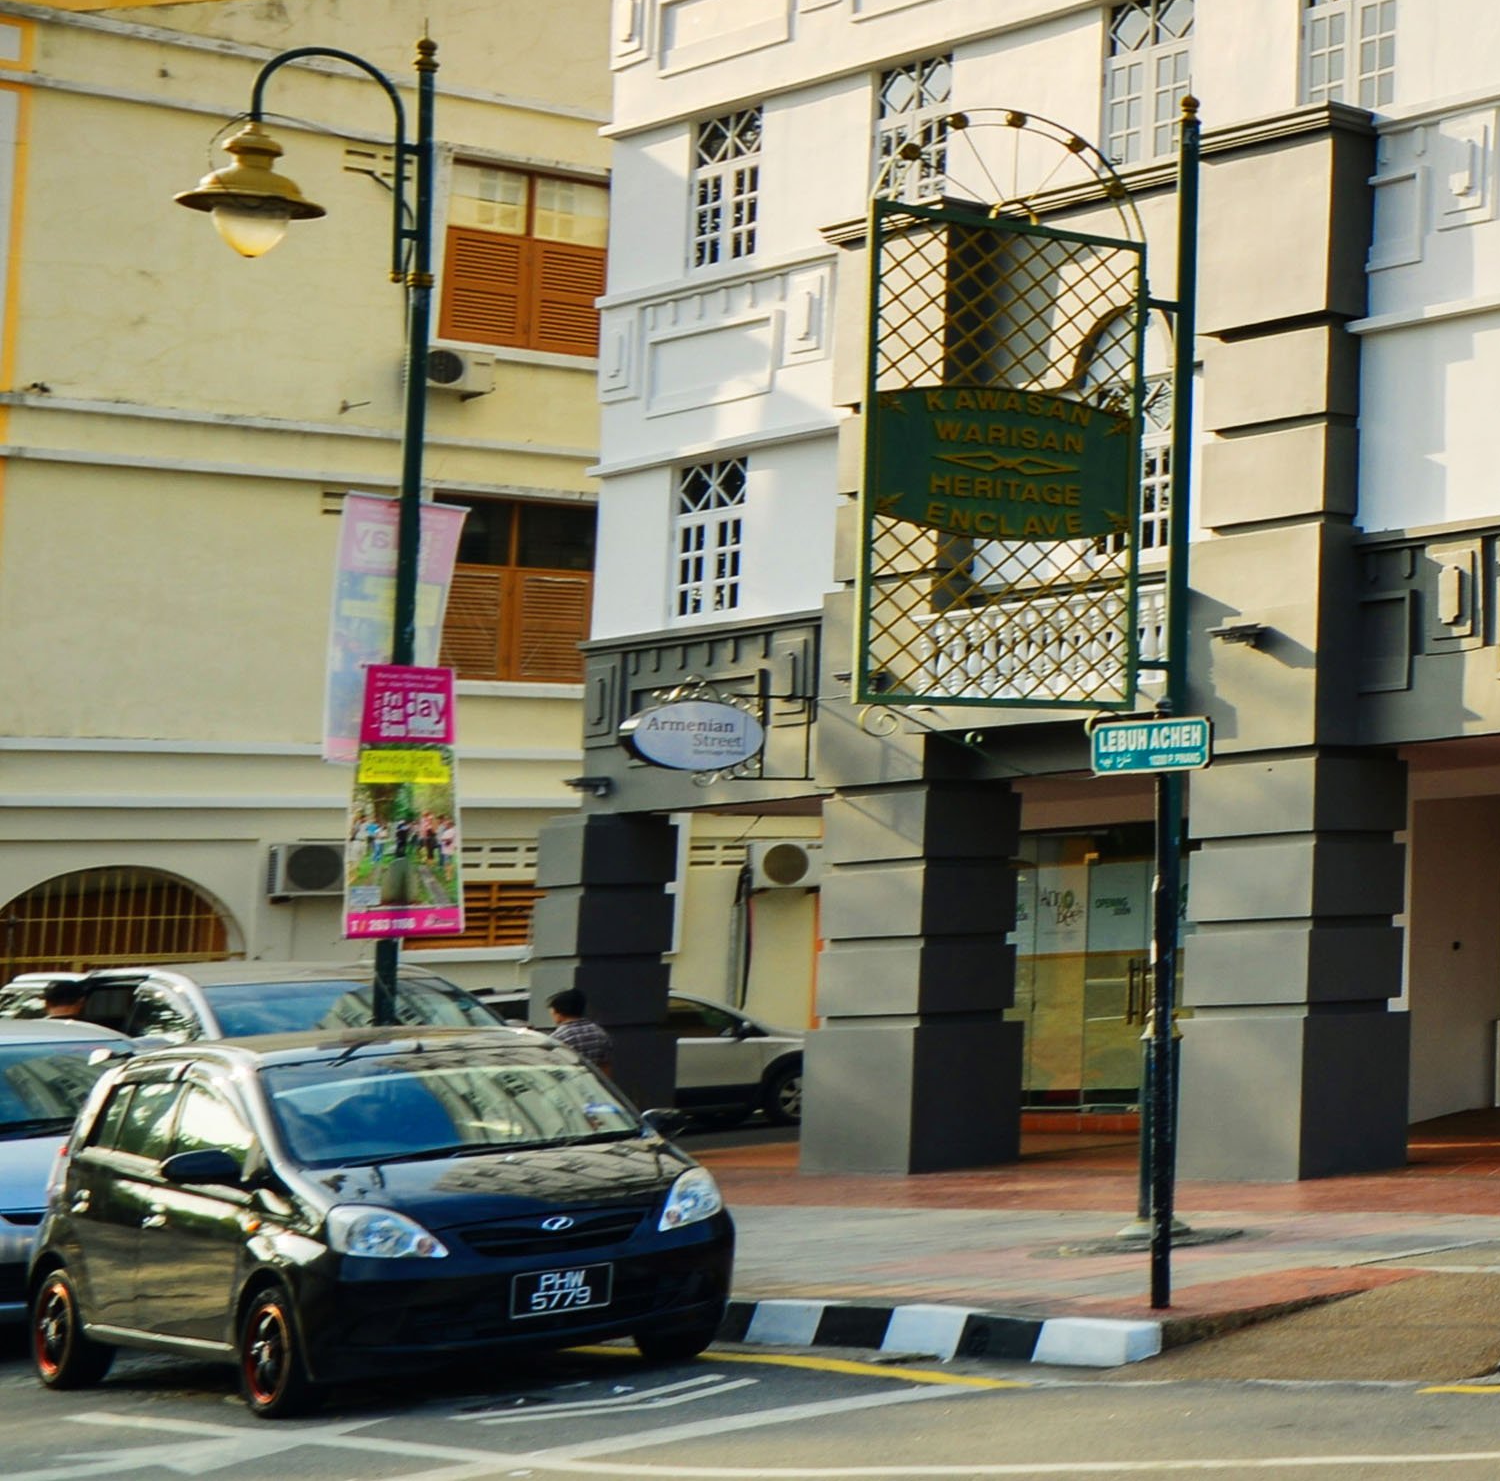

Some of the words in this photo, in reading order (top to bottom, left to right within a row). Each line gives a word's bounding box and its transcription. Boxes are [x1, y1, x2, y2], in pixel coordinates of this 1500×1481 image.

[926, 390, 1093, 428] KAWASAN
[935, 420, 1084, 454] WARISAN
[929, 473, 1081, 506] HERITAGE
[926, 502, 1082, 536] ENCLAVE
[646, 717, 734, 733] Armenian
[1098, 727, 1148, 753] LEBUH
[1150, 724, 1202, 749] ACHEH
[692, 734, 744, 748] Street
[539, 1269, 586, 1293] PHW
[531, 1286, 592, 1310] 5779
